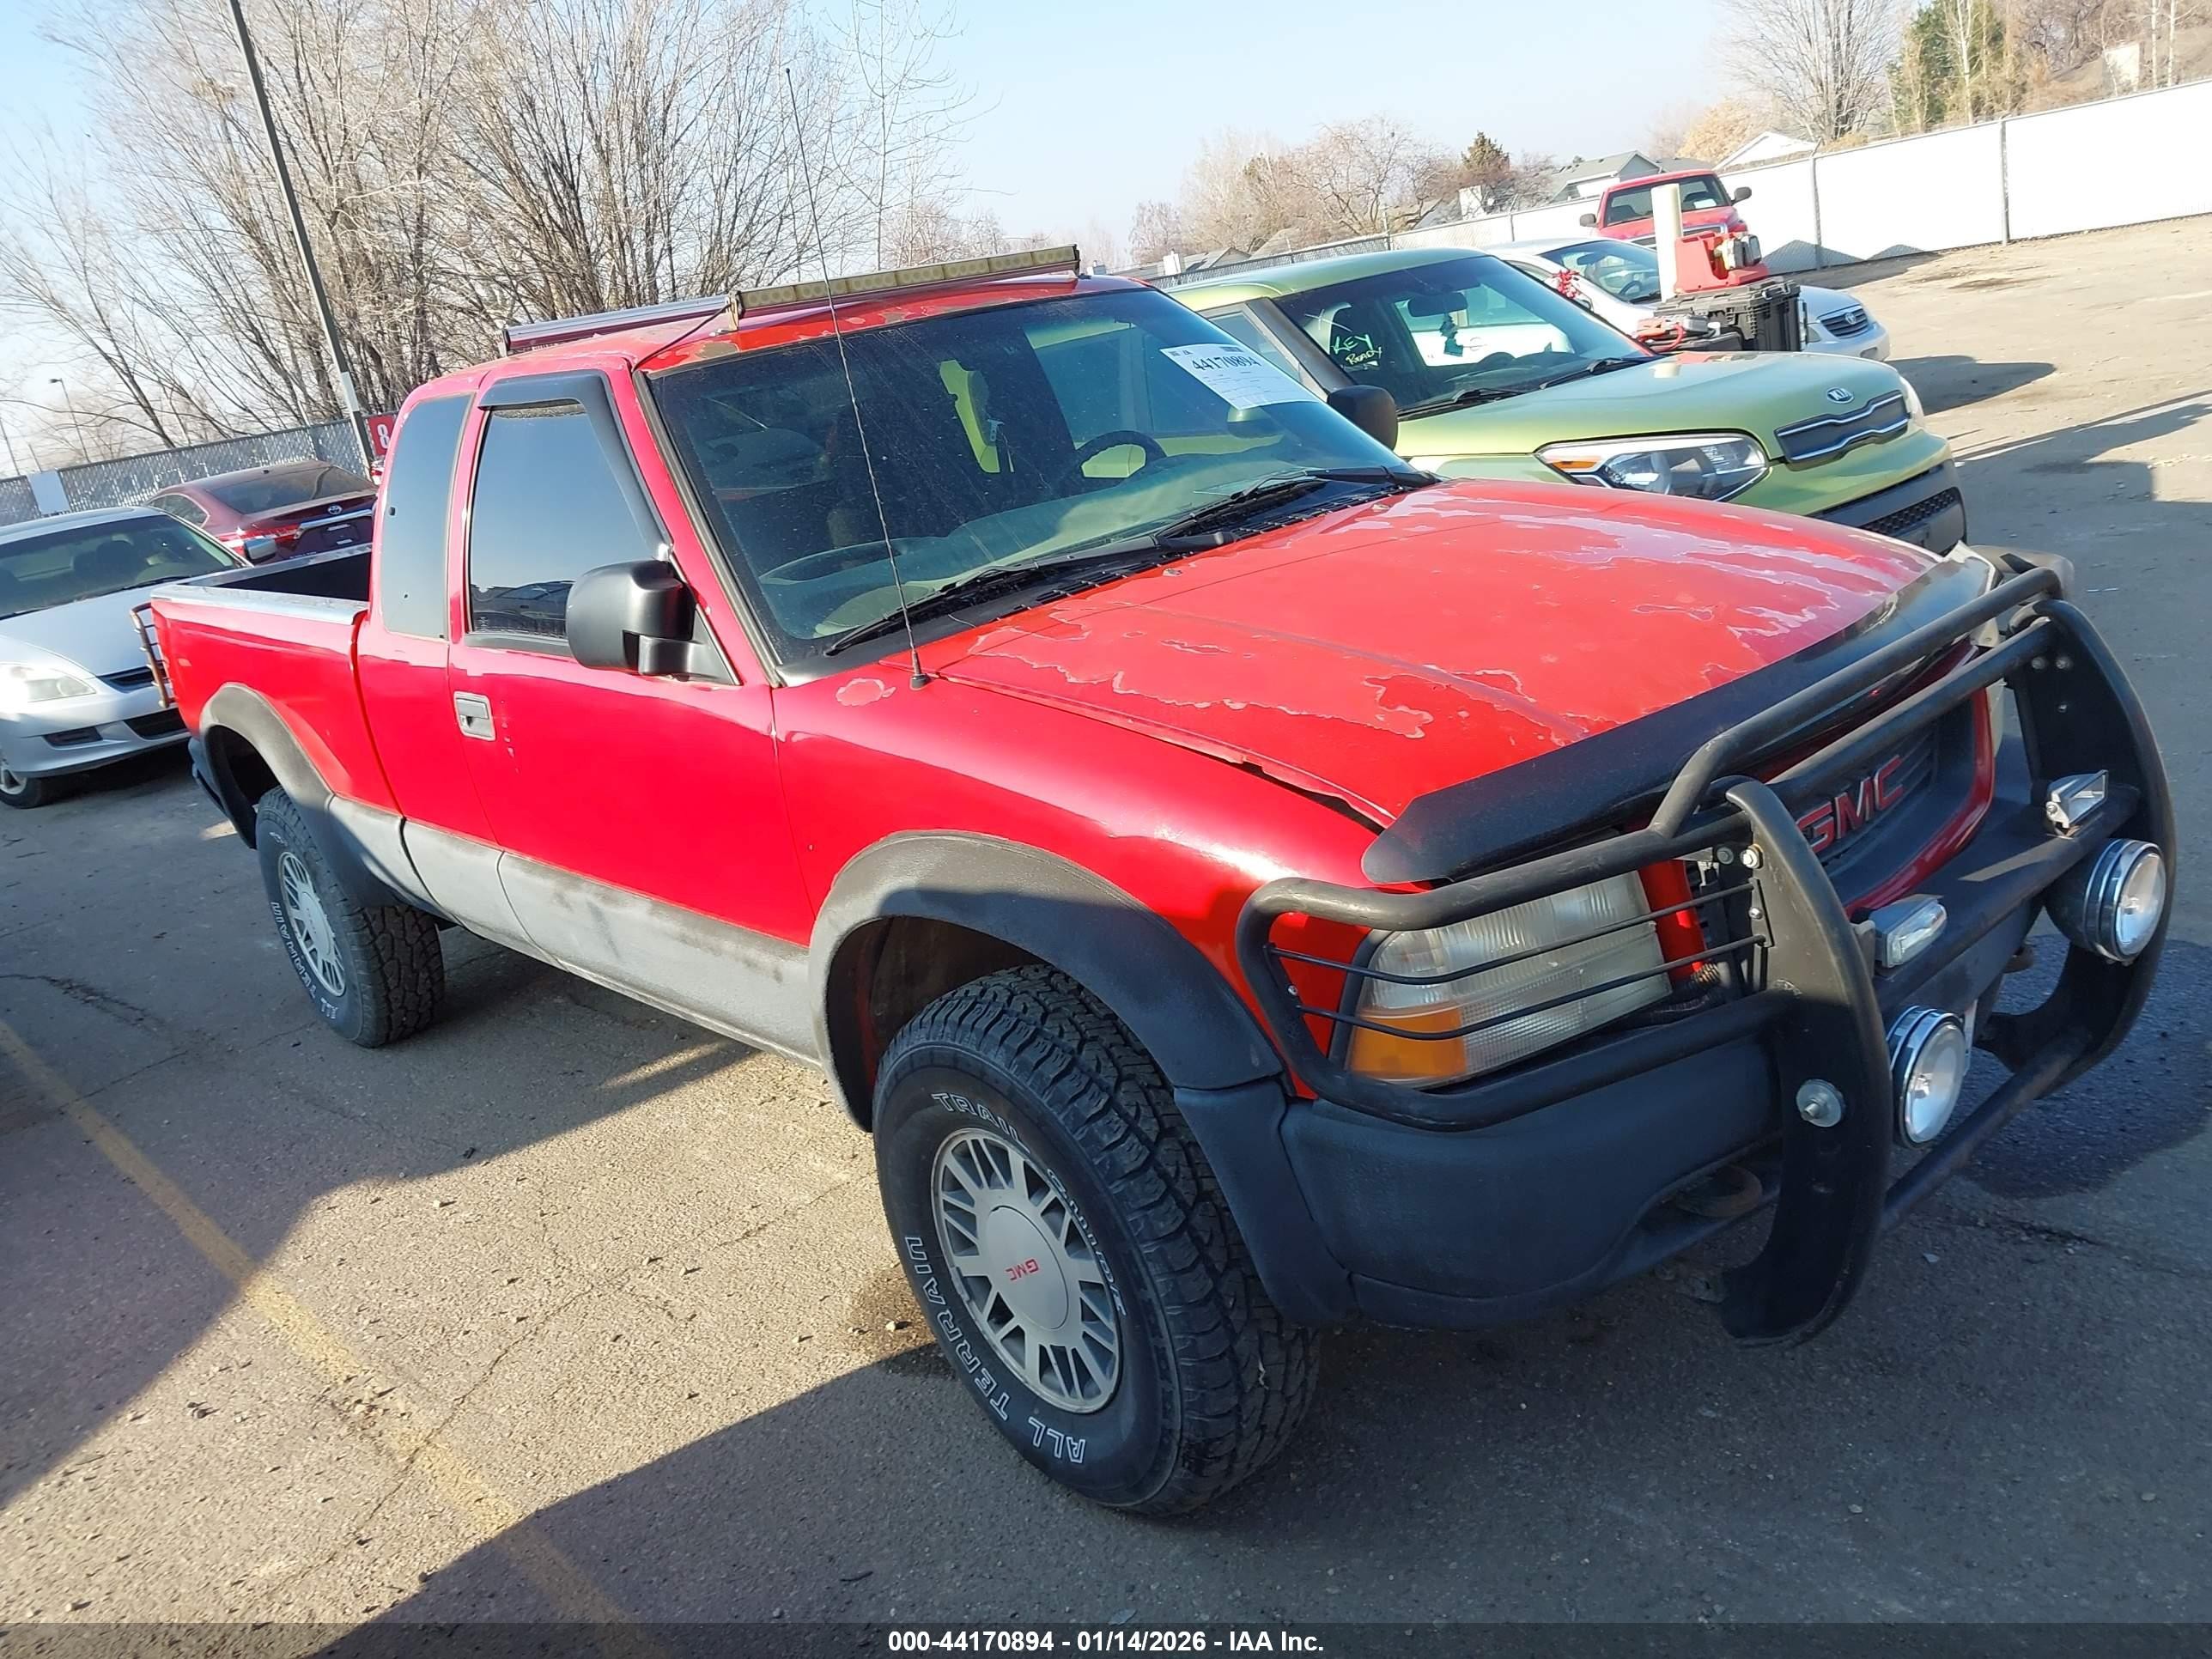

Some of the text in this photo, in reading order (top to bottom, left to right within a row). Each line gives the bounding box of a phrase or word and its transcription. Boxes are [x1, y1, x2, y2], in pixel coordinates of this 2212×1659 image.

[1331, 334, 1374, 355] KEY
[1345, 346, 1382, 365] READY
[1191, 356, 1262, 372] 44170894
[377, 423, 390, 449] 8
[1796, 755, 1904, 853] GMC
[932, 1092, 1030, 1153] TRAIL
[1005, 1258, 1040, 1281] GMC
[904, 1237, 1085, 1464] ALL TERRAIN
